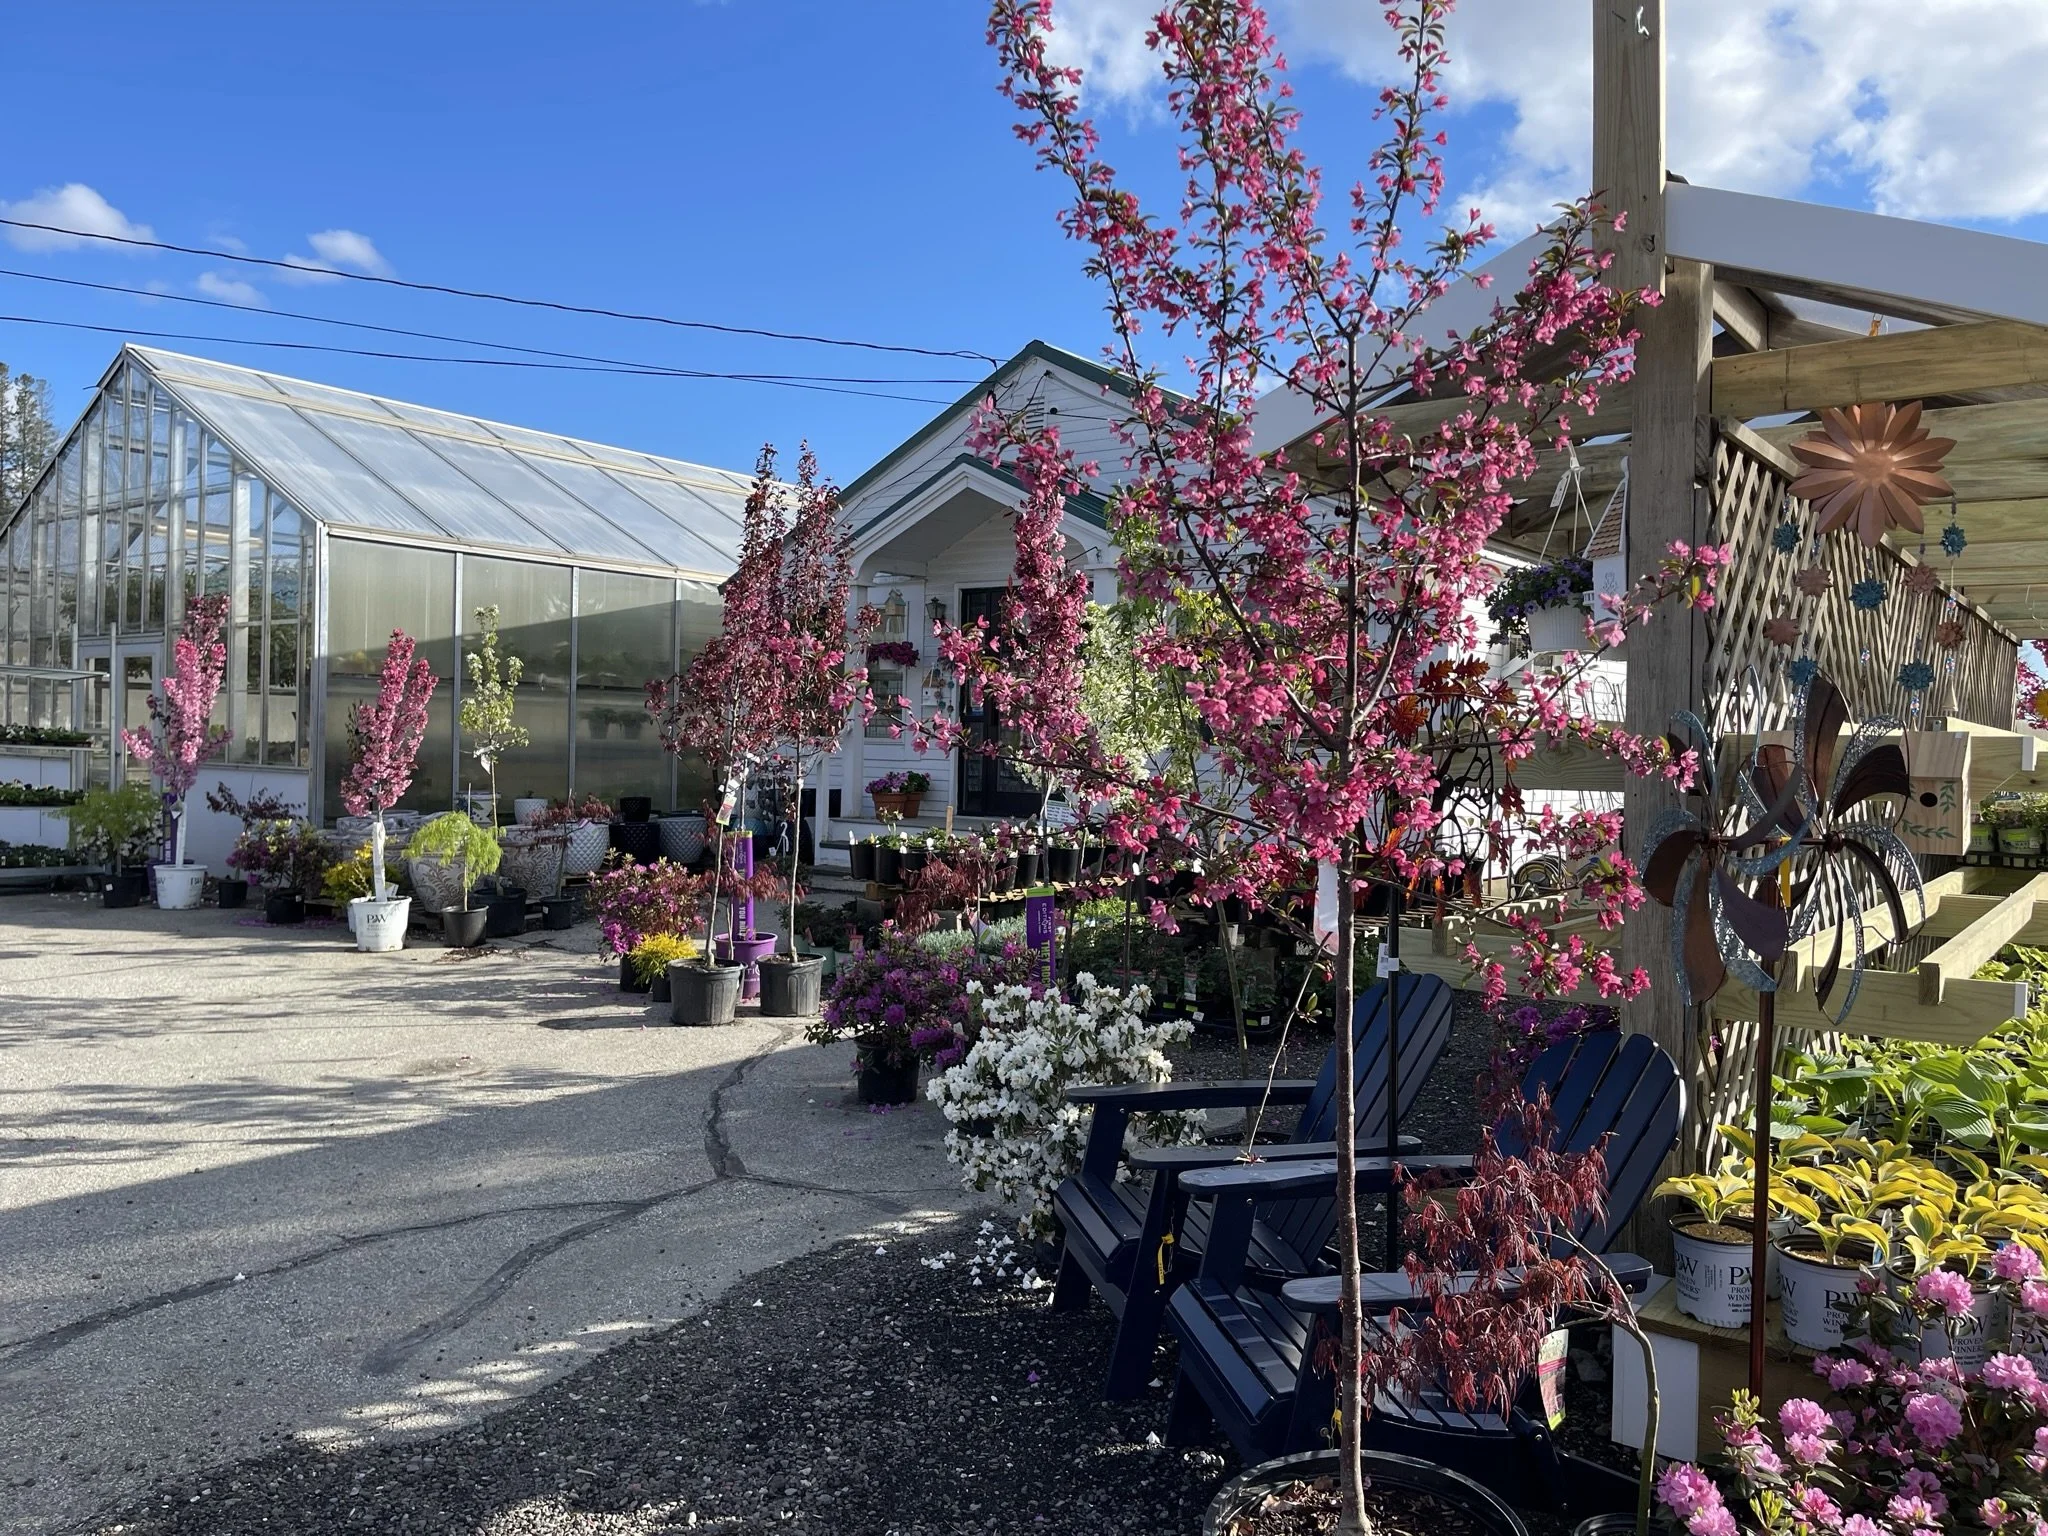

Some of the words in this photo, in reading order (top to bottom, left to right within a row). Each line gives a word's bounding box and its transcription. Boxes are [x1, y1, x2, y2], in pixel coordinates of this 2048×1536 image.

[367, 914, 388, 924] PW
[1041, 940, 1050, 962] THEY
[1727, 1293, 1751, 1302] WINN
